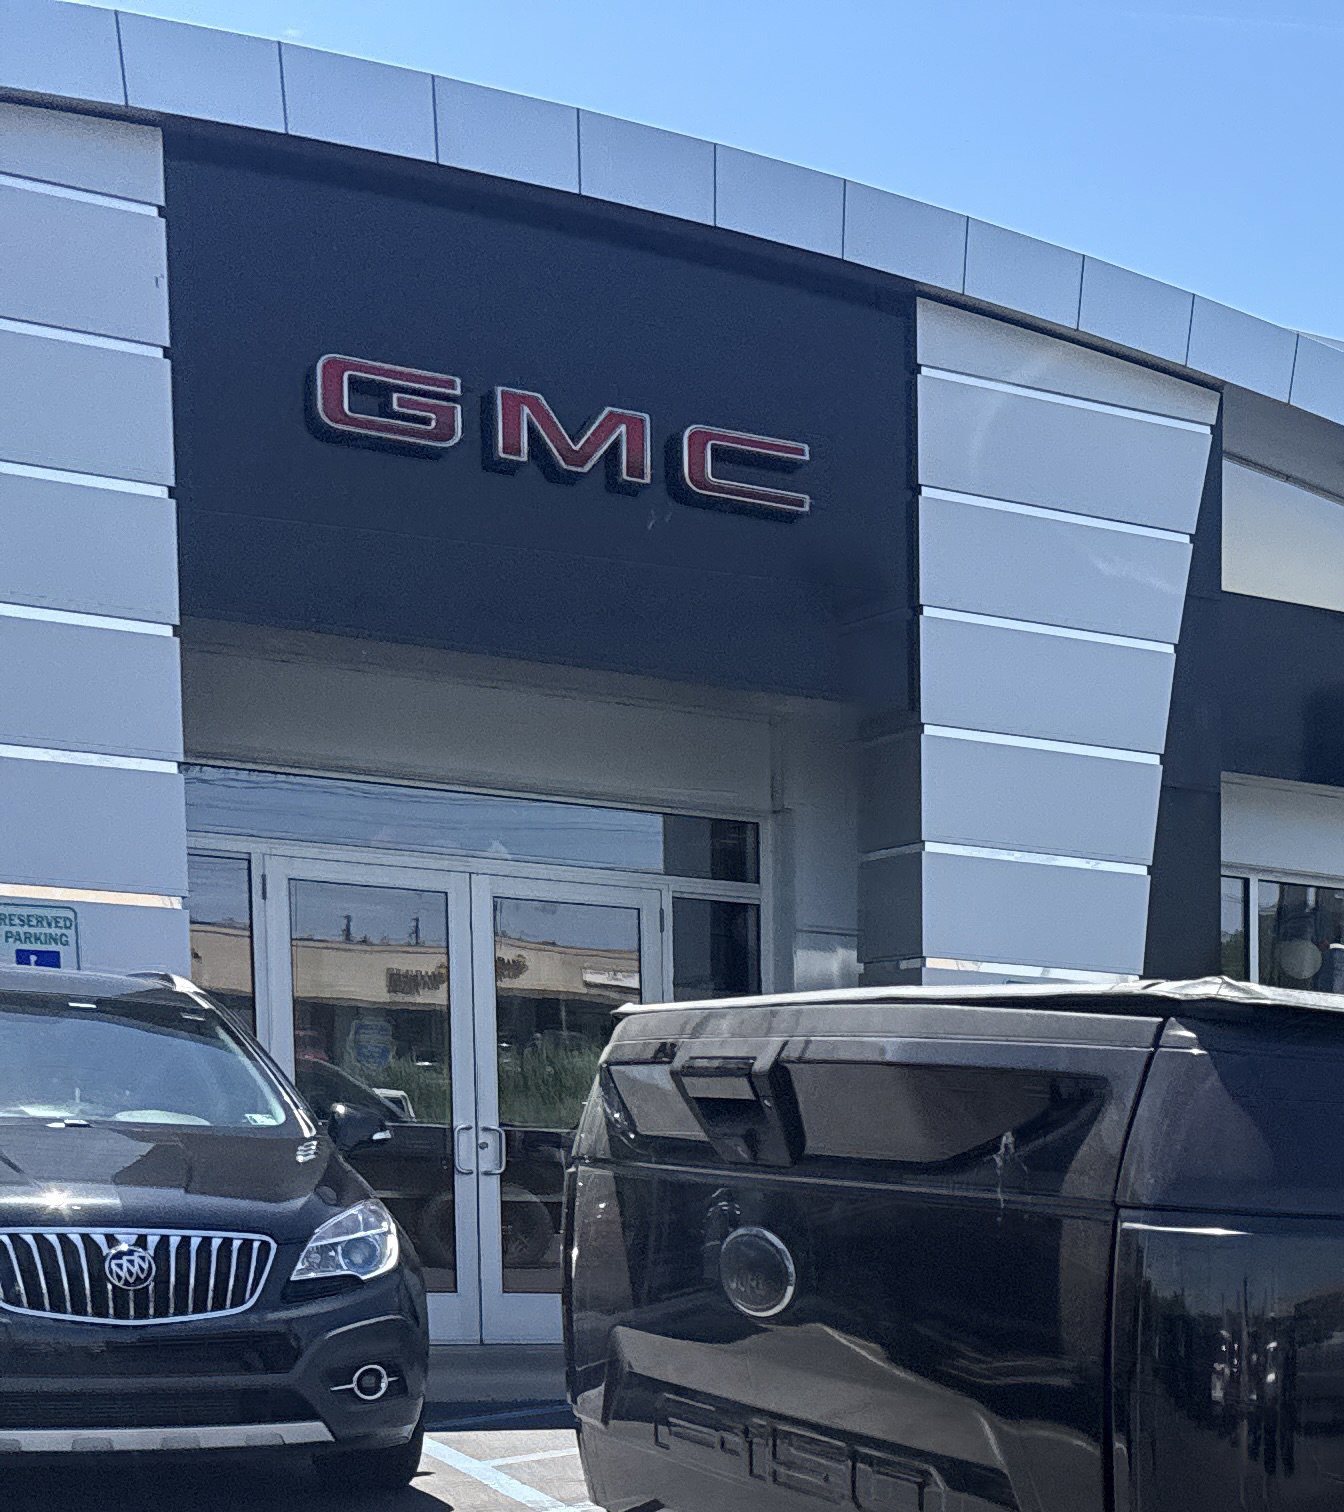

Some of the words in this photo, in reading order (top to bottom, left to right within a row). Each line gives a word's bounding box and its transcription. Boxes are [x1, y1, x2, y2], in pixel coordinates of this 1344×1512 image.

[315, 353, 810, 513] GMC
[0, 913, 73, 930] RESERVED
[4, 930, 69, 946] PARKING
